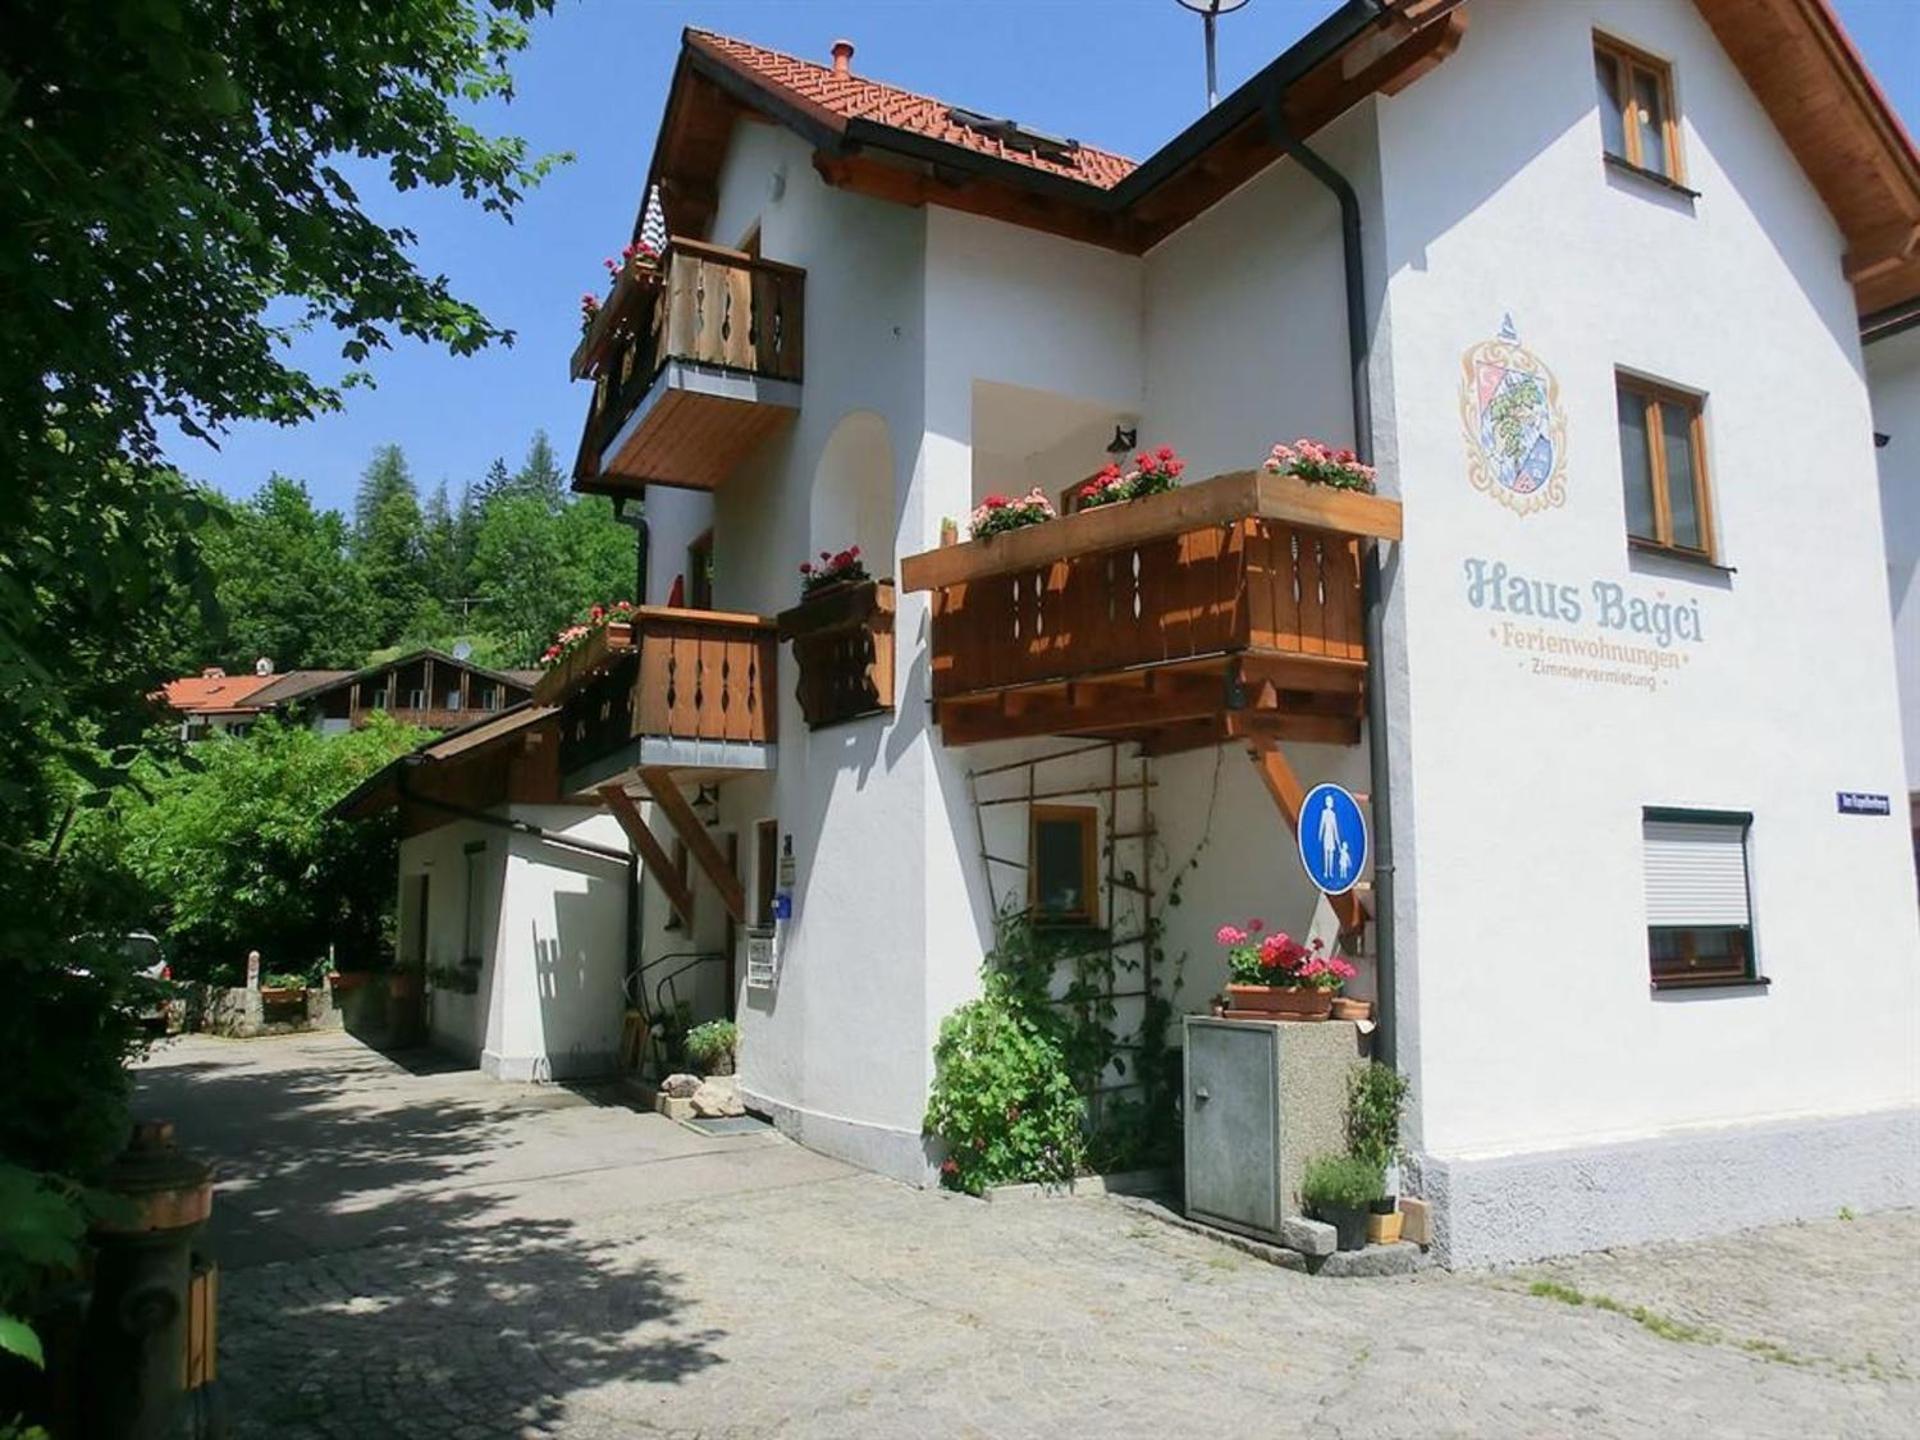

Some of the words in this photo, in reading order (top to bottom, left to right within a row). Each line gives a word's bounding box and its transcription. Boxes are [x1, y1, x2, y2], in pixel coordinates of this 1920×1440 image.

[1464, 558, 1583, 624] Haus
[1501, 621, 1680, 672] Ferienwohnungen
[1531, 657, 1656, 692] Zimmervermietung
